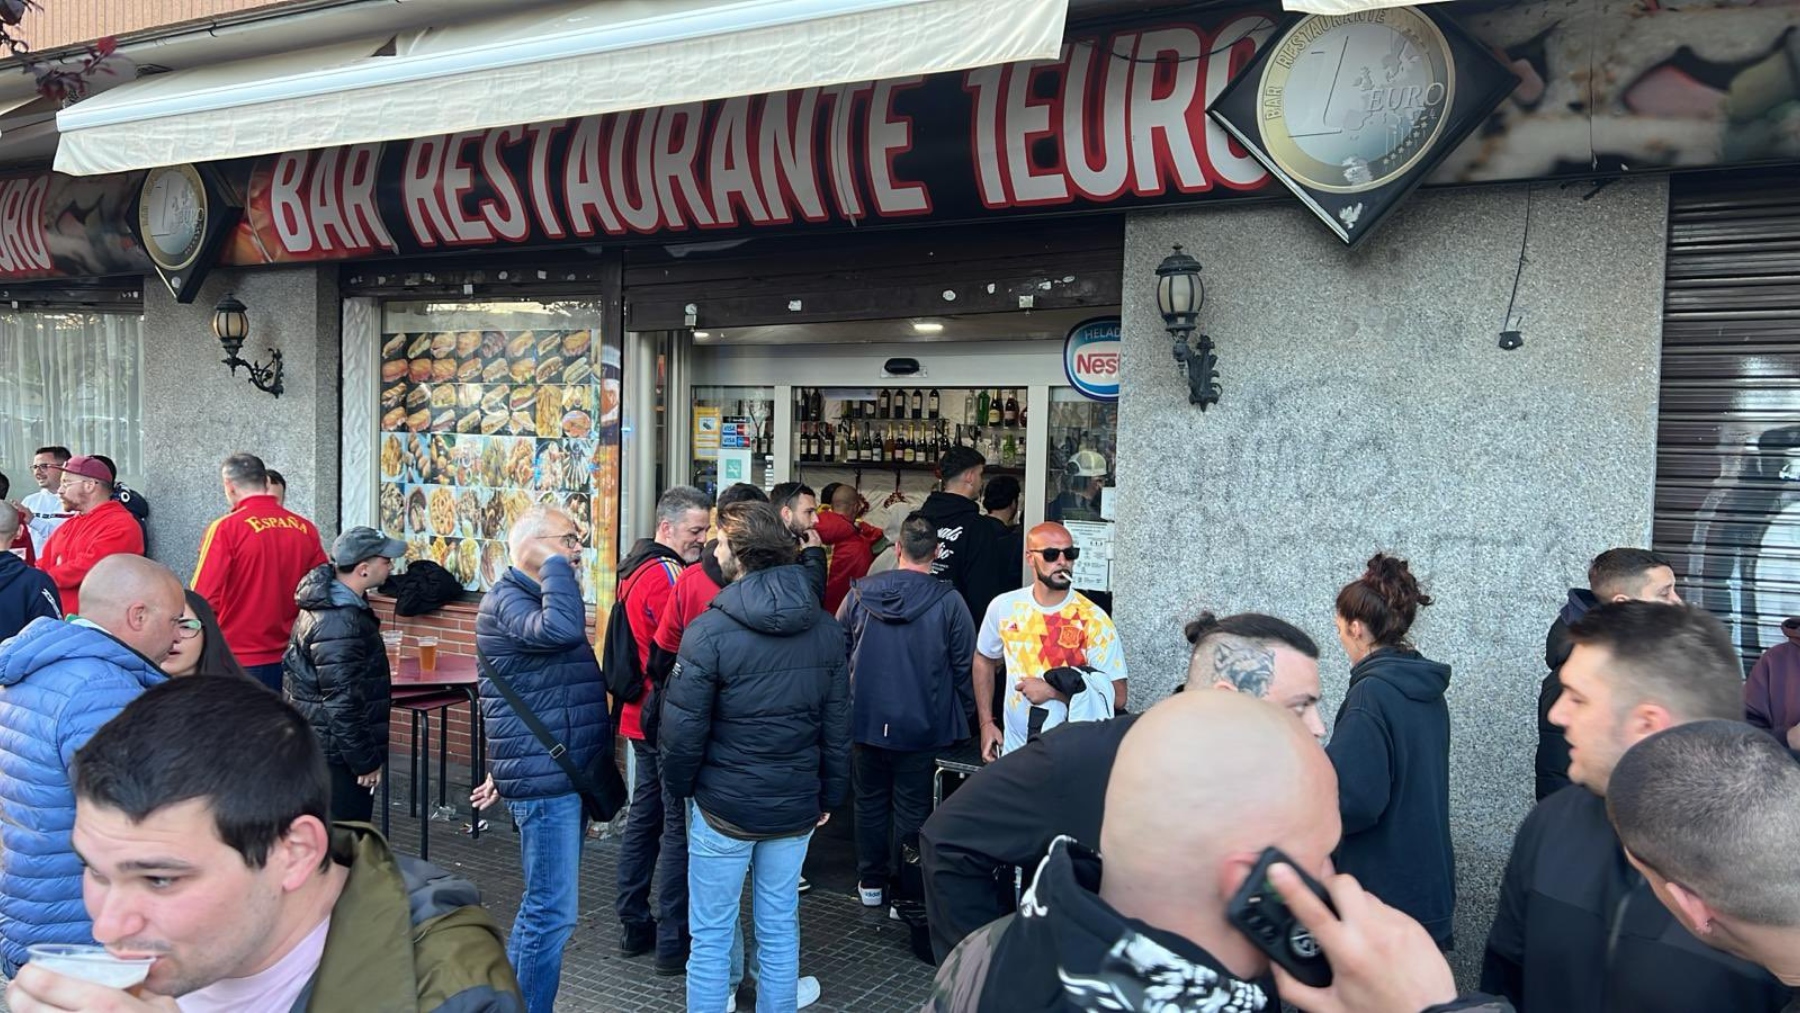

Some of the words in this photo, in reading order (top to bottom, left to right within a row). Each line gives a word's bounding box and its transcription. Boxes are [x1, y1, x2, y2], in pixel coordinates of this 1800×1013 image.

[1265, 86, 1283, 120] BAR
[1368, 82, 1445, 113] EURO
[271, 142, 391, 251] BAR
[404, 76, 930, 240] RESTAURANTE
[965, 18, 1273, 204] 1EURO
[245, 516, 307, 534] ESPAÑA
